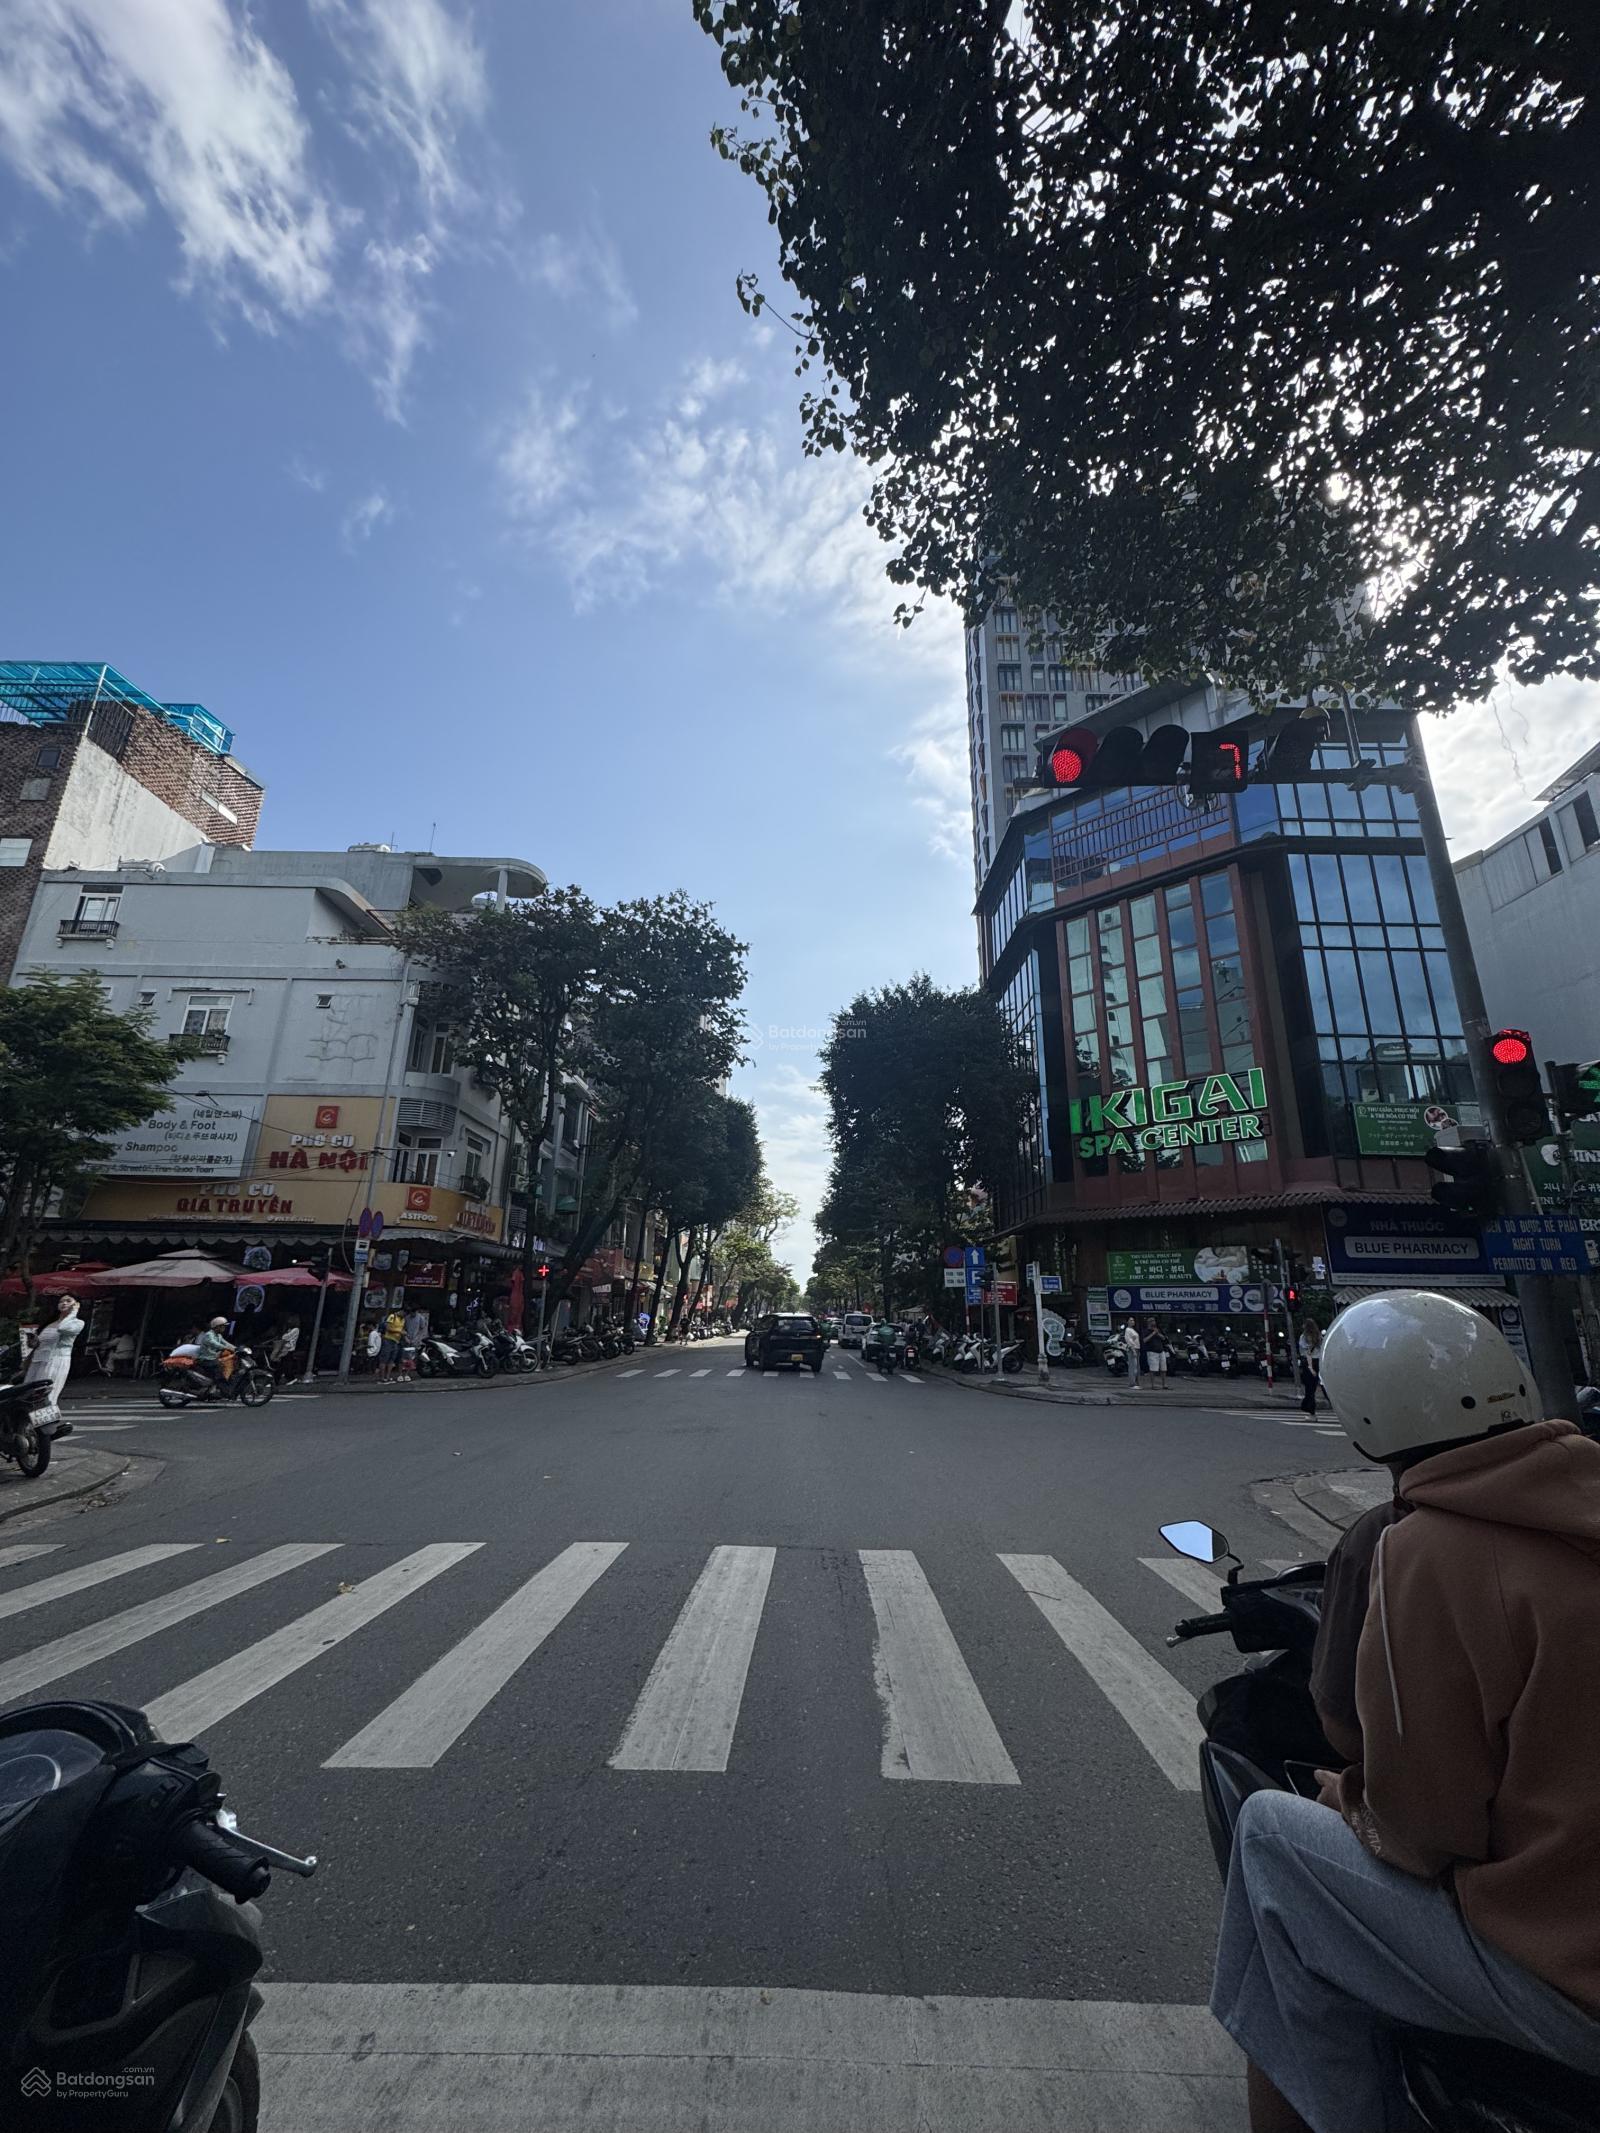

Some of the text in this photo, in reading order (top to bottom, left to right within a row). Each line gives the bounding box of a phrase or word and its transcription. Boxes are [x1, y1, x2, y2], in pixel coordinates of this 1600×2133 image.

[1218, 741, 1243, 782] 7
[1070, 1067, 1268, 1134] IKIGAI
[148, 1120, 177, 1131] Body
[190, 1120, 216, 1130] Foot
[1079, 1115, 1263, 1159] SPA CENTER
[125, 1141, 178, 1154] Shampoo
[269, 1149, 368, 1173] HÀ NỘI
[176, 1199, 211, 1213] GIA
[1369, 1218, 1399, 1232] NHÀ
[1355, 1242, 1469, 1255] BLUE PHARMACY
[1511, 1237, 1562, 1251] RIGHT TURN
[1492, 1257, 1577, 1271] PERMITTED ON RED
[1145, 1290, 1212, 1299] BLUE PHARMACY
